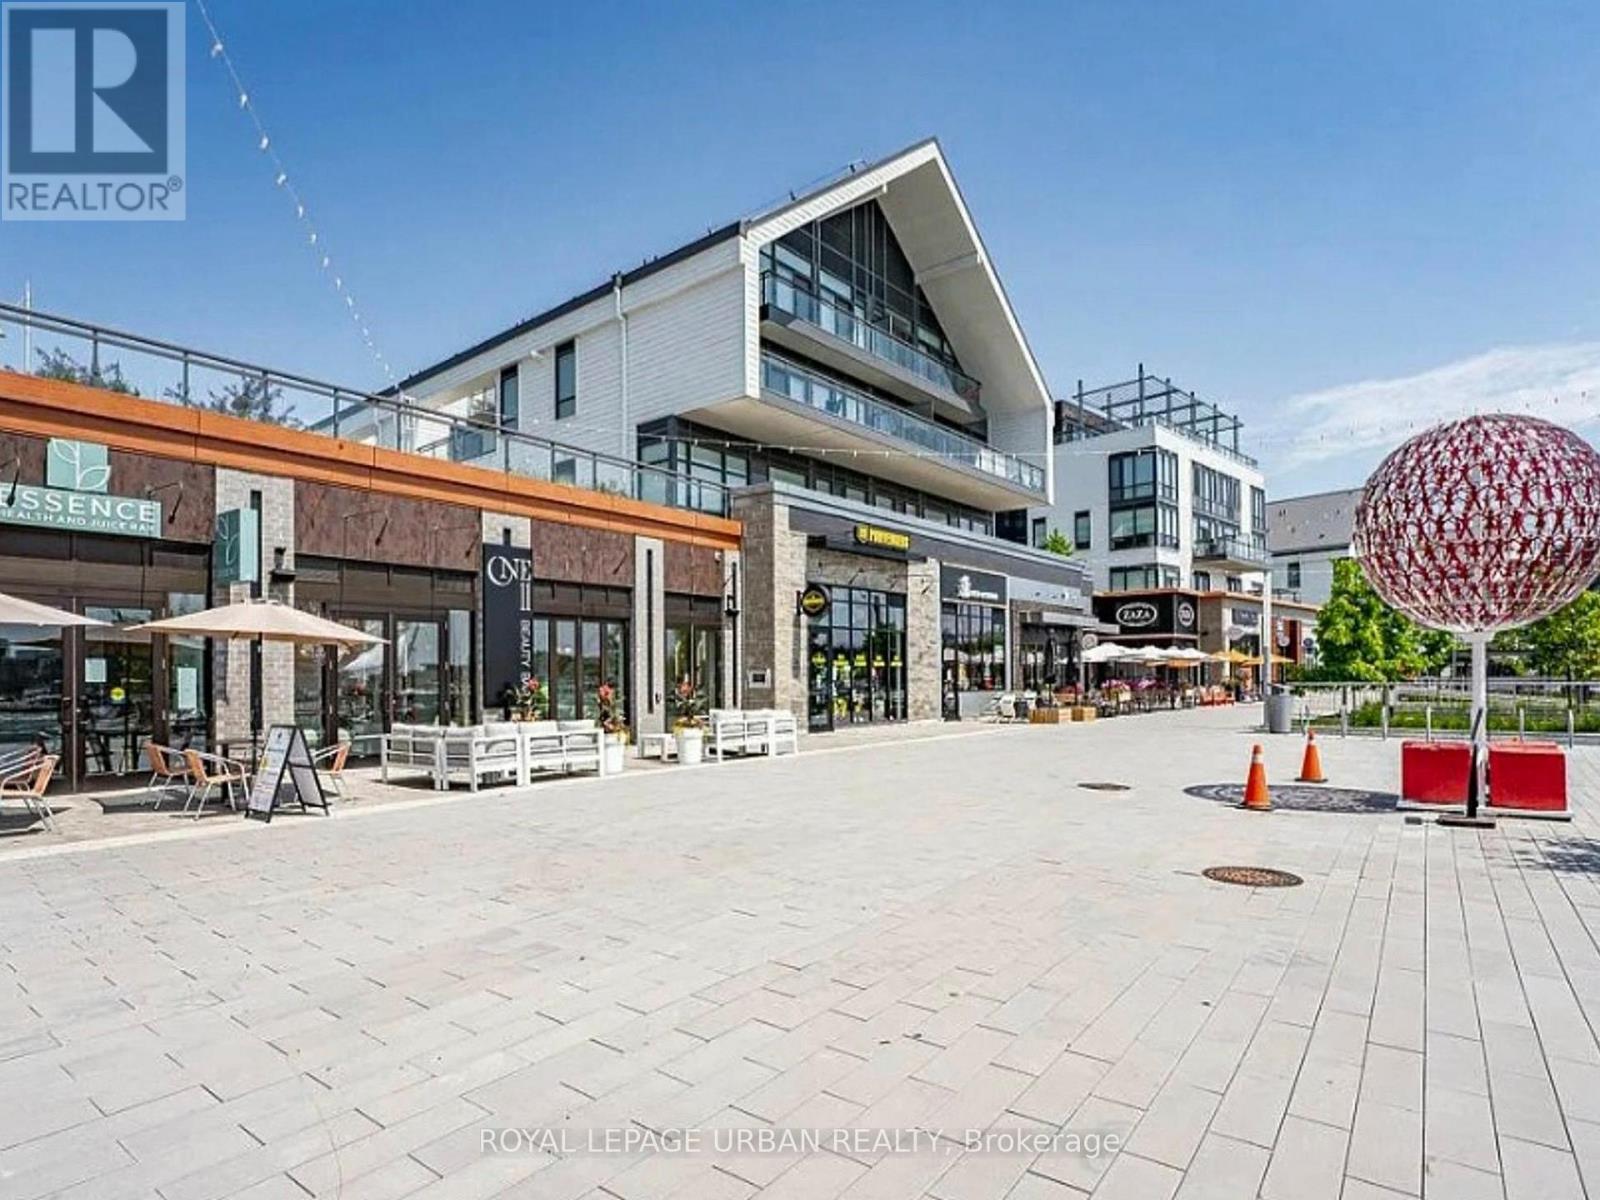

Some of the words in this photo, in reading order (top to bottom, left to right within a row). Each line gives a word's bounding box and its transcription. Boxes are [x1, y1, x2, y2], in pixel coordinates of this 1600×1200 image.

[0, 488, 155, 524] ESSENCE
[56, 514, 87, 526] AND
[91, 519, 128, 530] JUICE
[487, 555, 532, 587] ONE
[520, 619, 532, 667] BEAUTY
